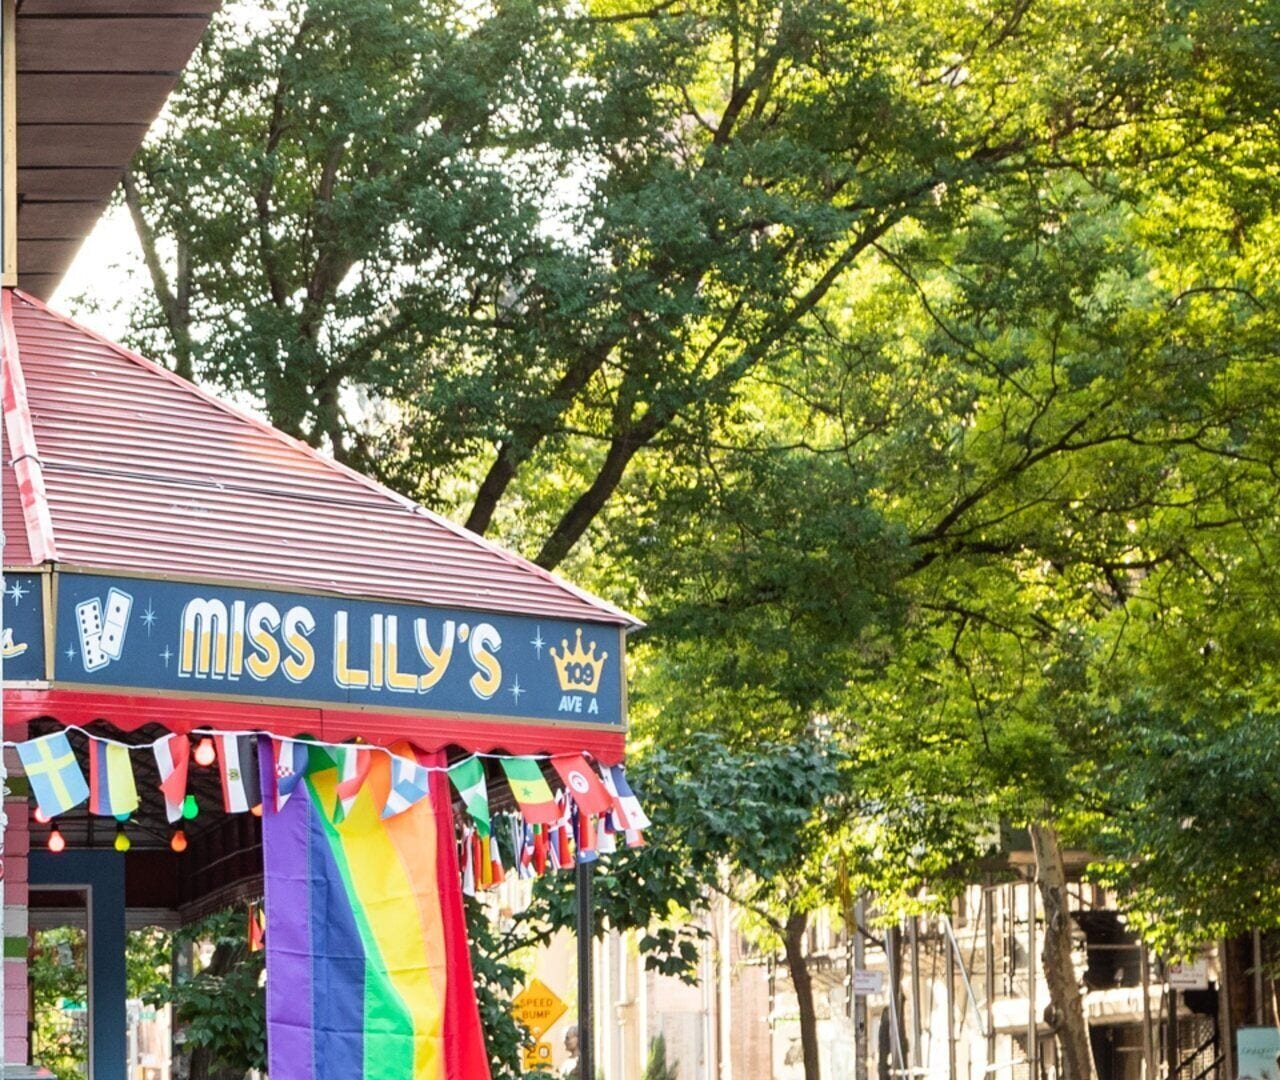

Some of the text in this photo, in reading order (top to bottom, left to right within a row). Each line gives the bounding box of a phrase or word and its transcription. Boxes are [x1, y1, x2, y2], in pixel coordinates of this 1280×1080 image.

[178, 597, 502, 700] MISS LILY'S
[564, 661, 594, 686] 109
[558, 695, 598, 714] AVE A
[520, 998, 553, 1007] SPEED
[522, 1010, 550, 1019] BUMP
